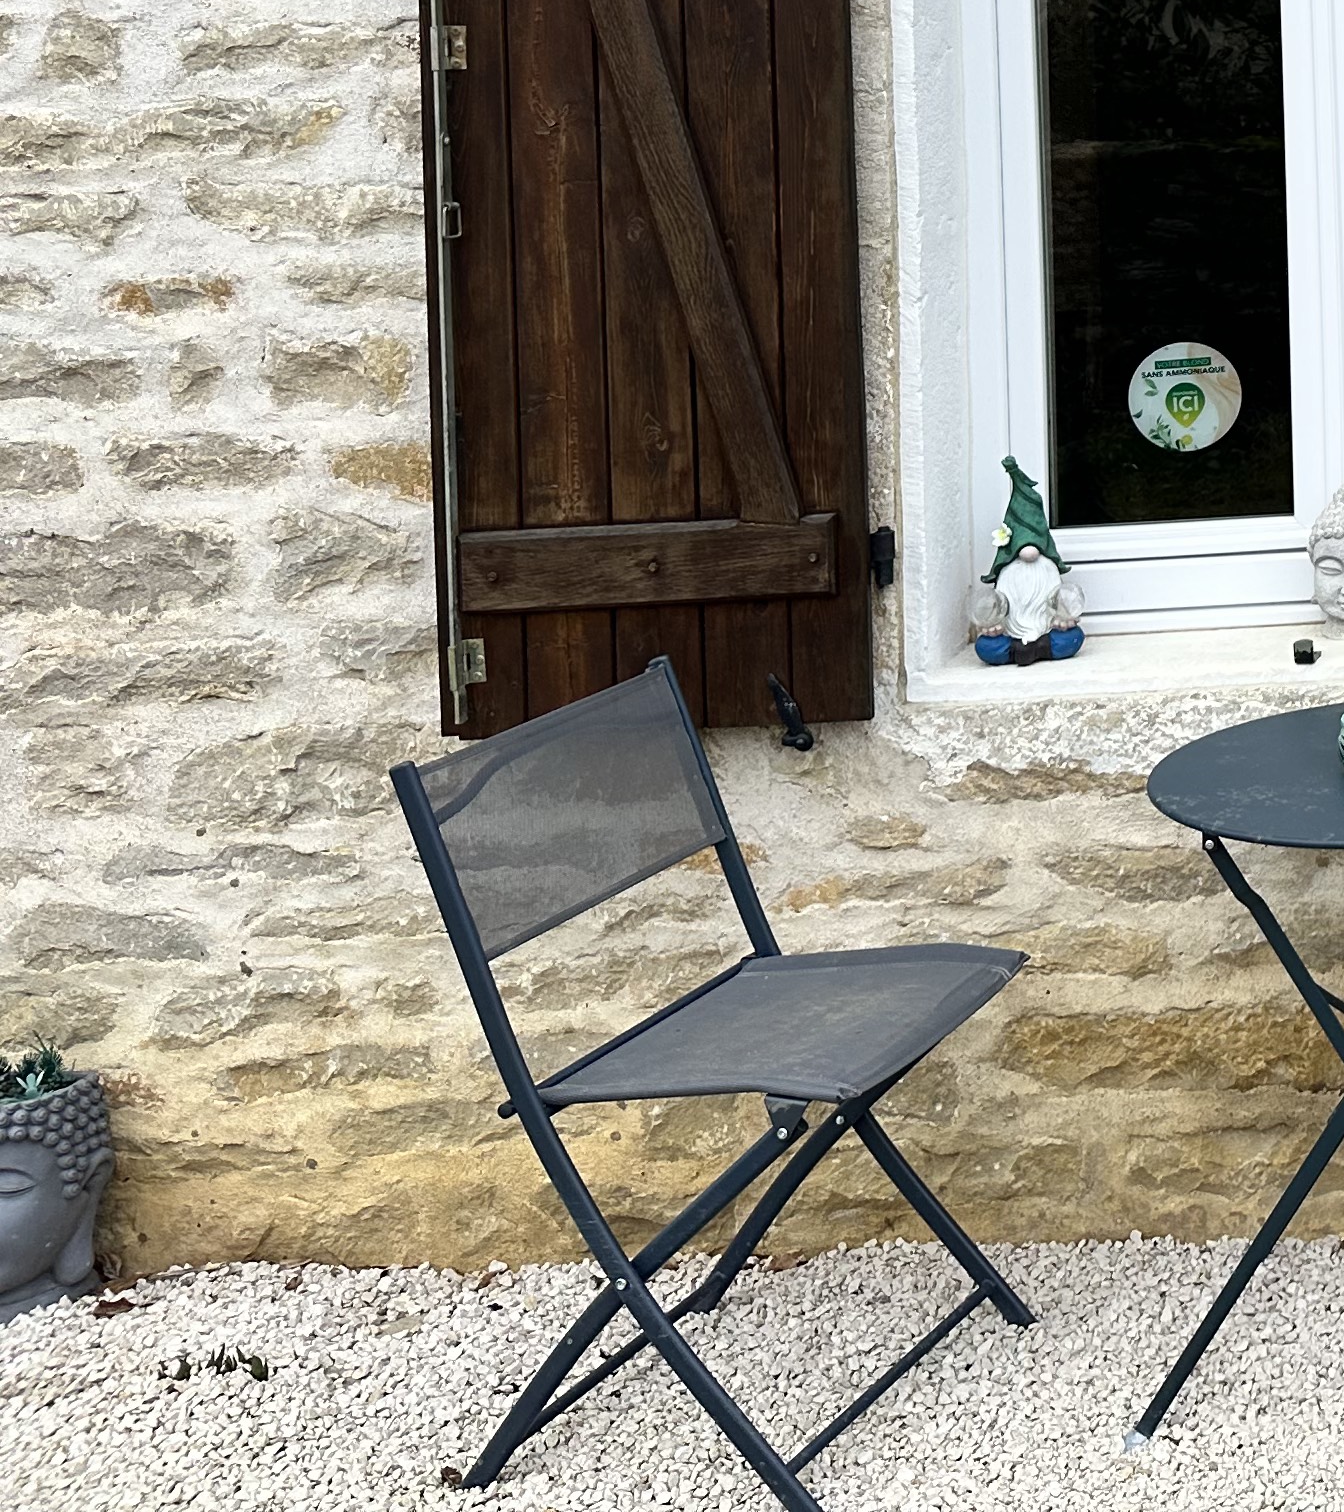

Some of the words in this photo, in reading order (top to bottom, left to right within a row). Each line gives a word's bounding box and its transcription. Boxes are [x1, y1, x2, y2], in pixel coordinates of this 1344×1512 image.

[1141, 371, 1164, 379] SANS
[1166, 366, 1226, 377] AMMONIAQUE
[1172, 395, 1199, 412] ICI
